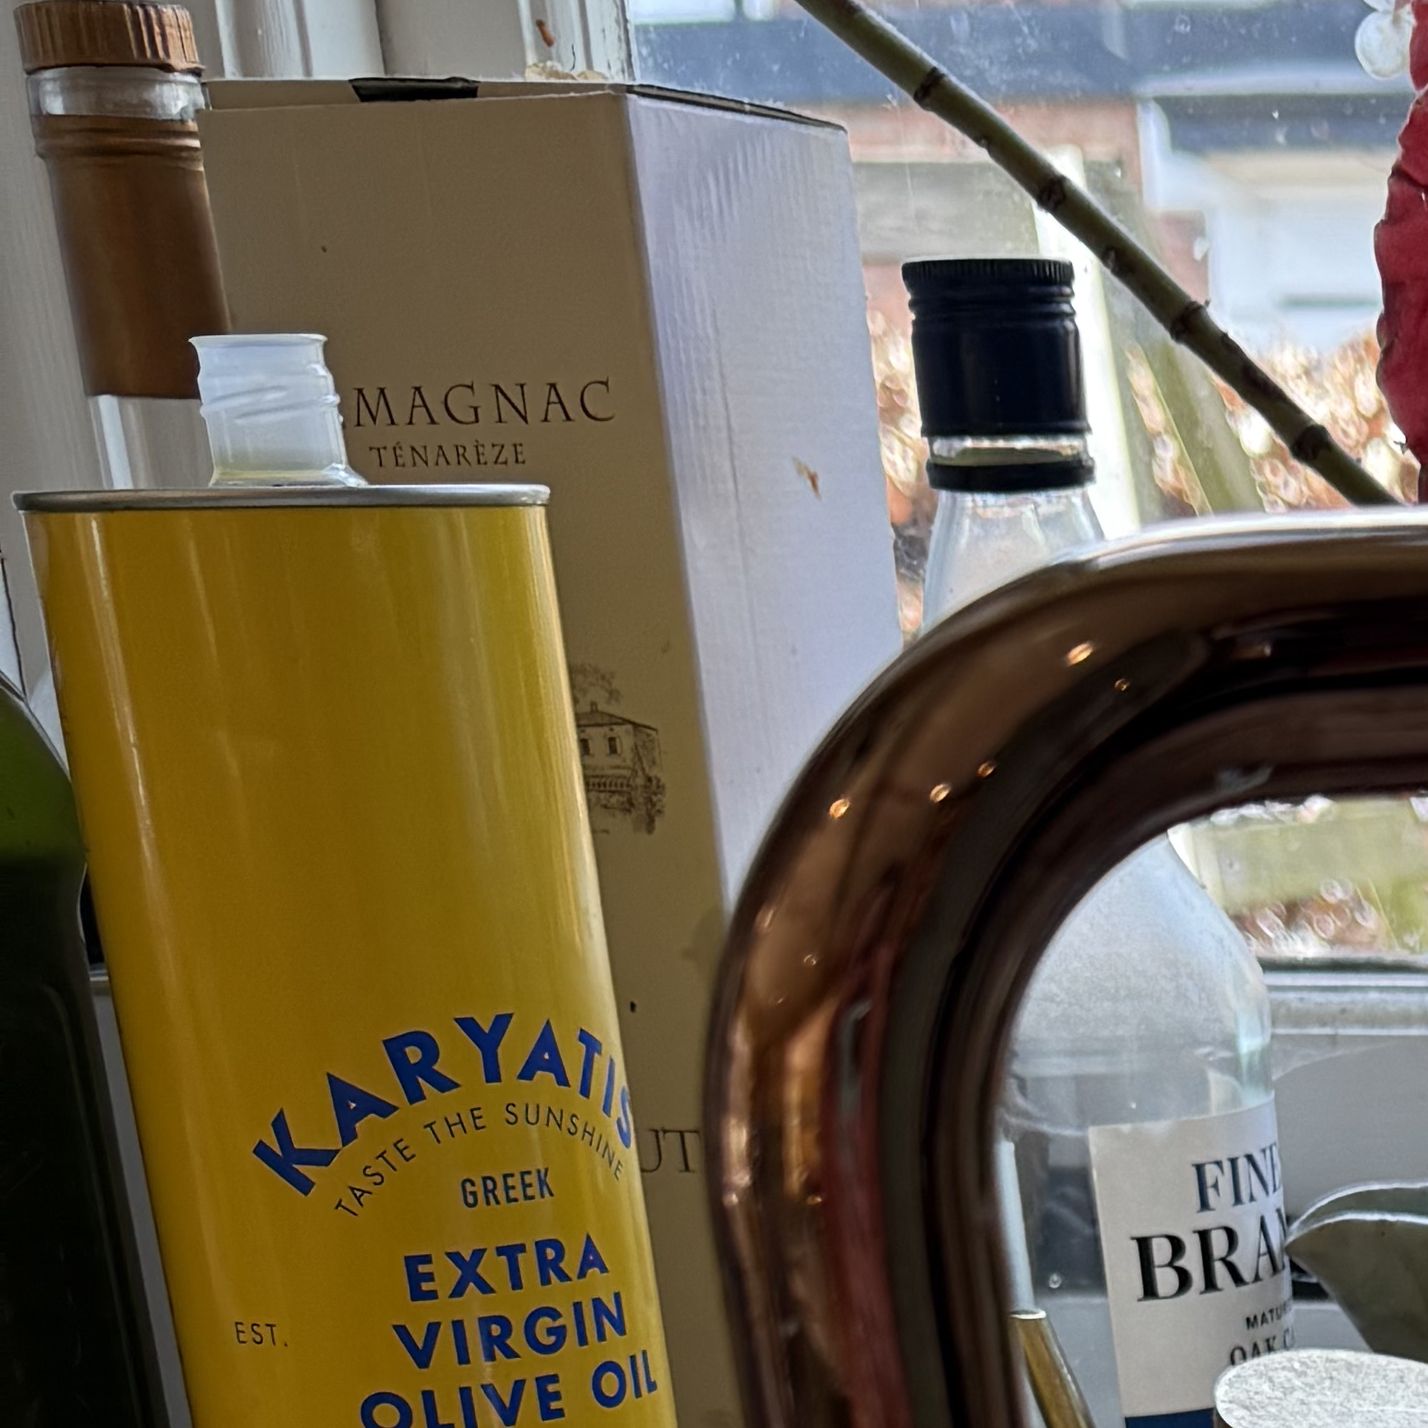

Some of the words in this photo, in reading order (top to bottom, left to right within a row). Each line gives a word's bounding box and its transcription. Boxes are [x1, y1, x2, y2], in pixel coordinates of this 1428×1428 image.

[341, 376, 616, 428] MAGNAC
[368, 439, 527, 469] TÉNARÈZE
[252, 1012, 632, 1197] KARYATIS
[334, 1138, 416, 1217] TASTE
[424, 1106, 487, 1145] THE
[505, 1102, 624, 1182] SUNSHINE
[460, 1167, 555, 1209] GREEK
[1192, 1142, 1280, 1214] FINE
[404, 1231, 610, 1303] EXTRA
[234, 1321, 288, 1348] EST.
[392, 1290, 628, 1370] VIRGIN
[591, 1349, 659, 1409] OIL
